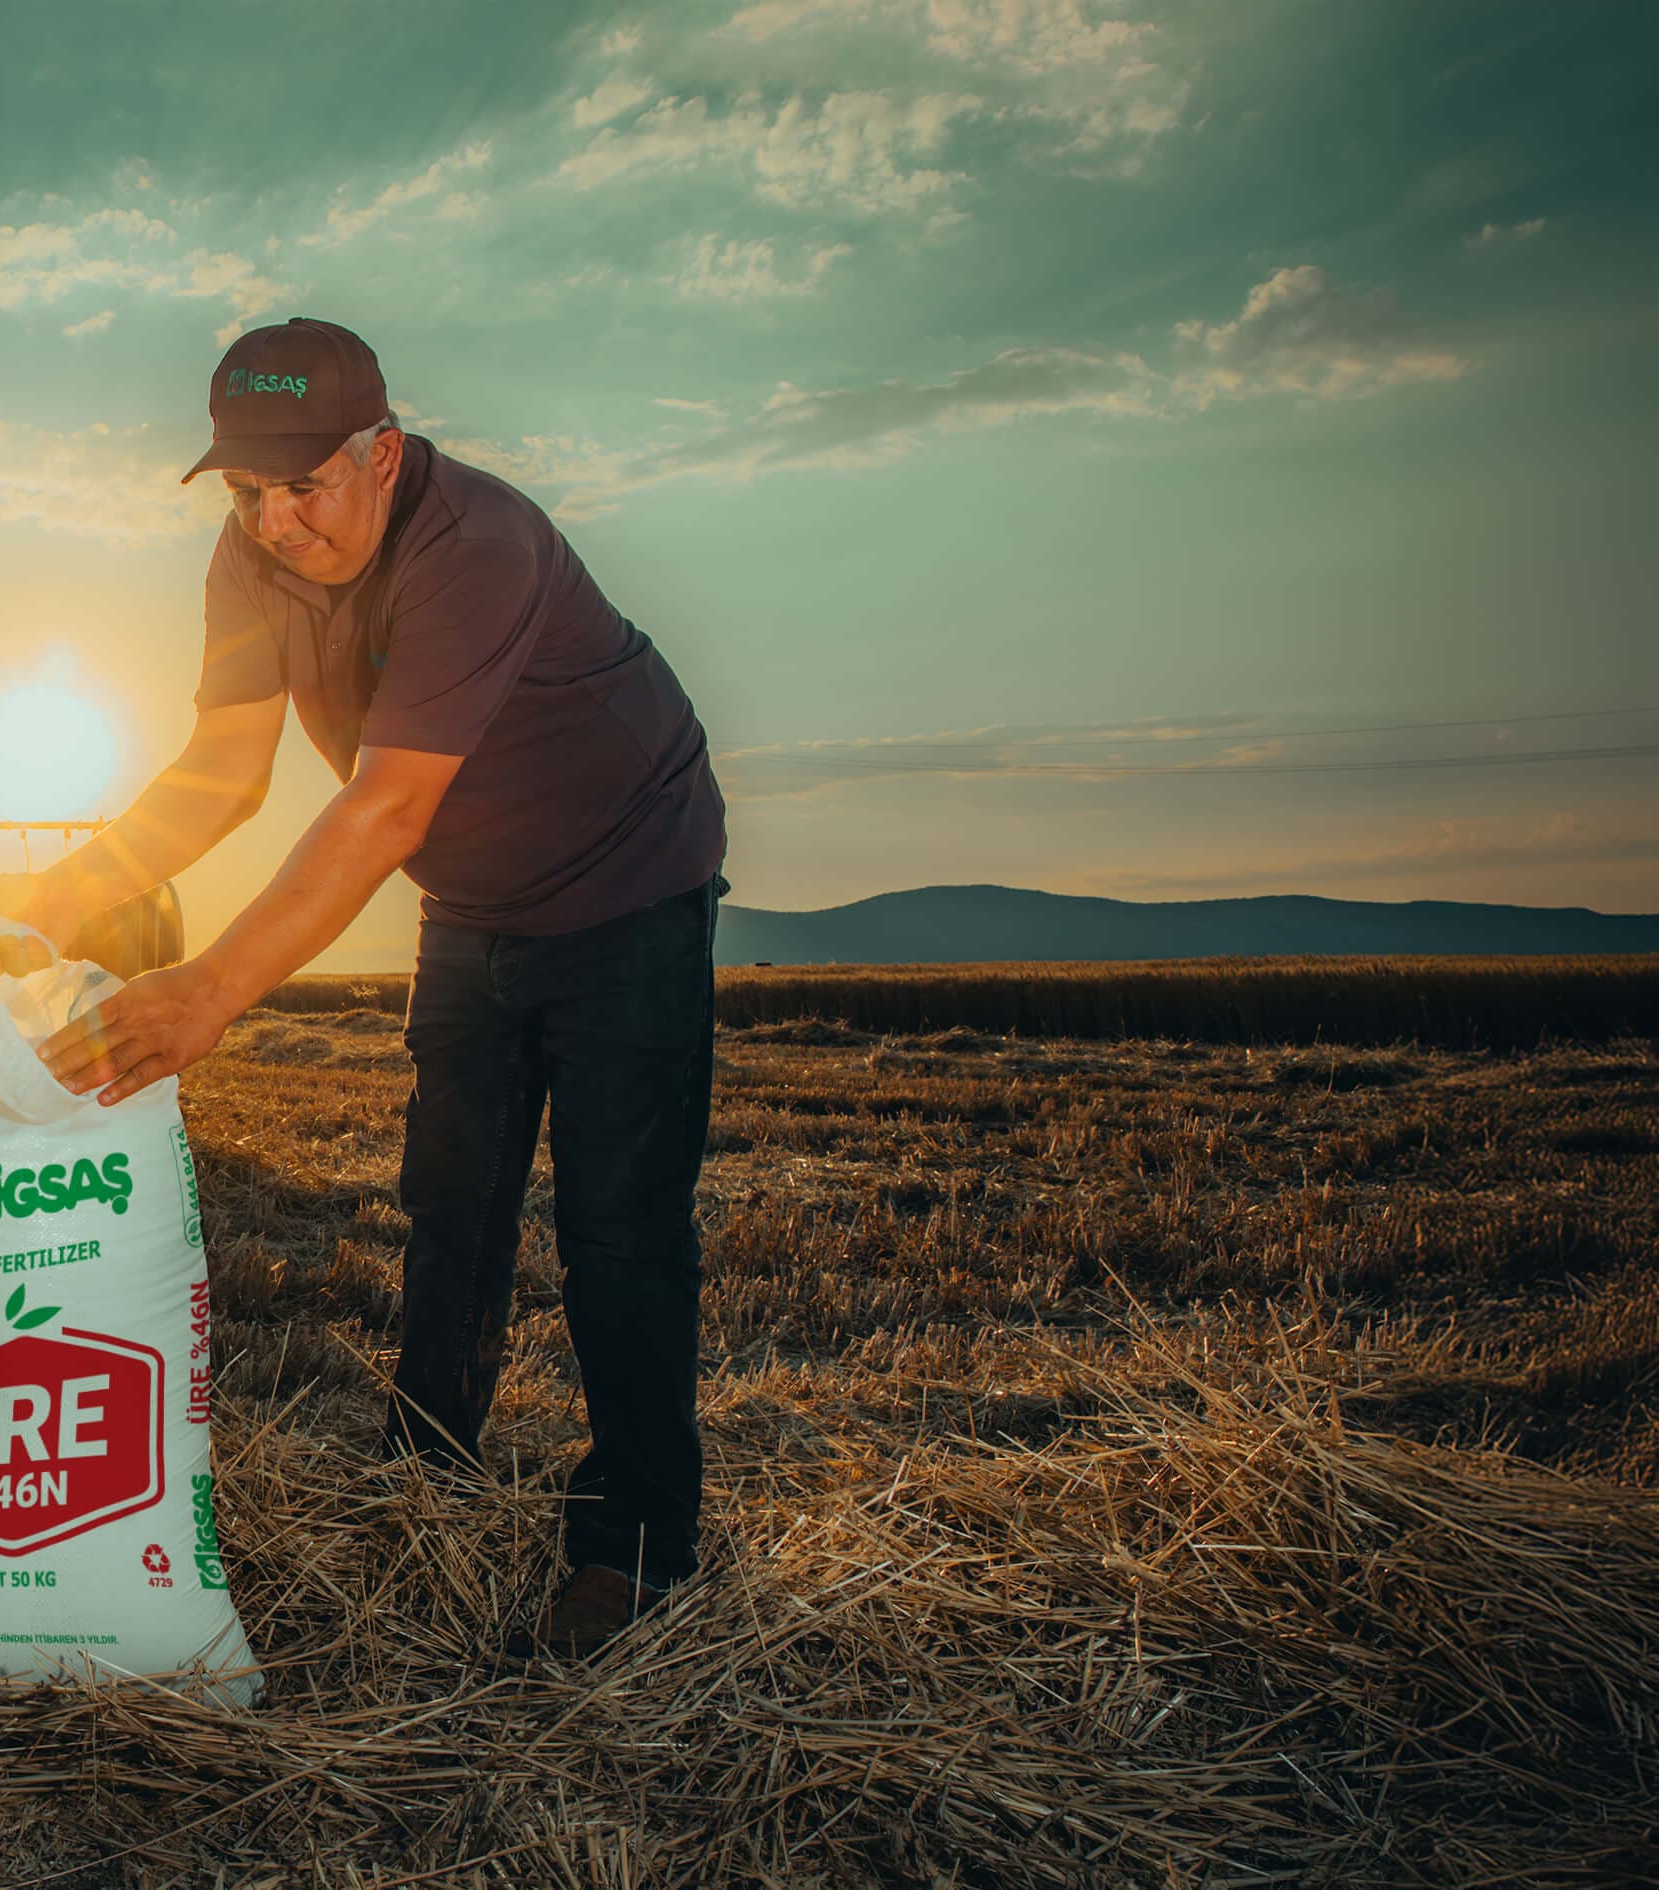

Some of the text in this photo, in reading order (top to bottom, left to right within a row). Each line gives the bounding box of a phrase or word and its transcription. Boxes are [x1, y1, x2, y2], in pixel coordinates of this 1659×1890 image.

[186, 1280, 211, 1424] ÜRE %46N
[11, 1571, 30, 1587] 50
[35, 1571, 56, 1587] KG
[80, 1635, 86, 1644] 3
